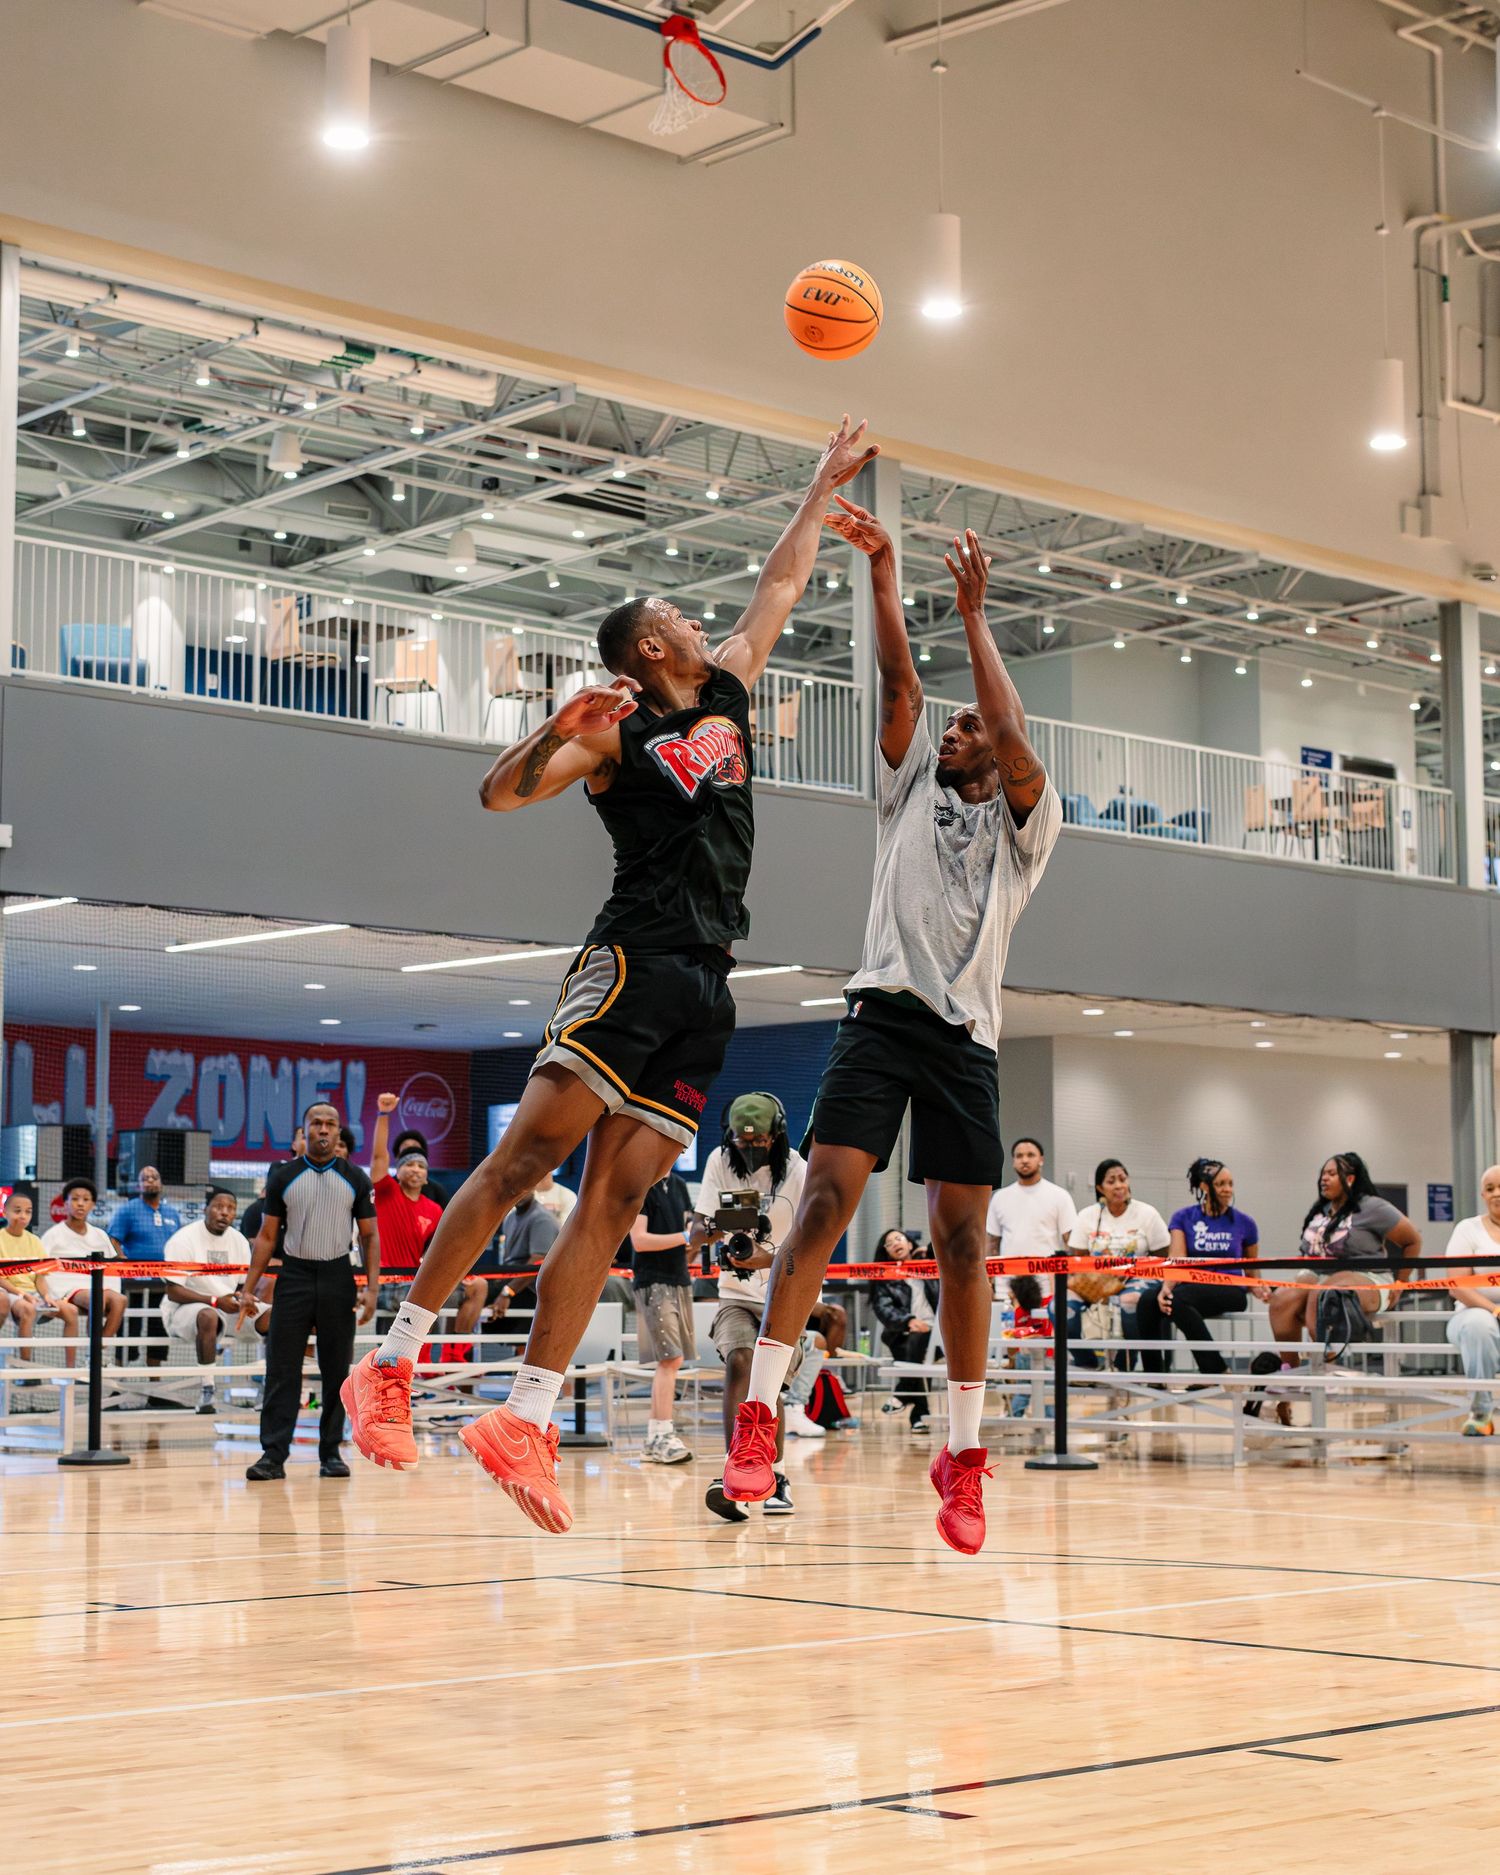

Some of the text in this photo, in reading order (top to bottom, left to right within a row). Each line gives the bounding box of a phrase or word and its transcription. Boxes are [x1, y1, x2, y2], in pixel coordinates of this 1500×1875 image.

[849, 1266, 885, 1278] DANGER
[906, 1265, 939, 1277] DANGE
[1028, 1260, 1069, 1273] DANGER
